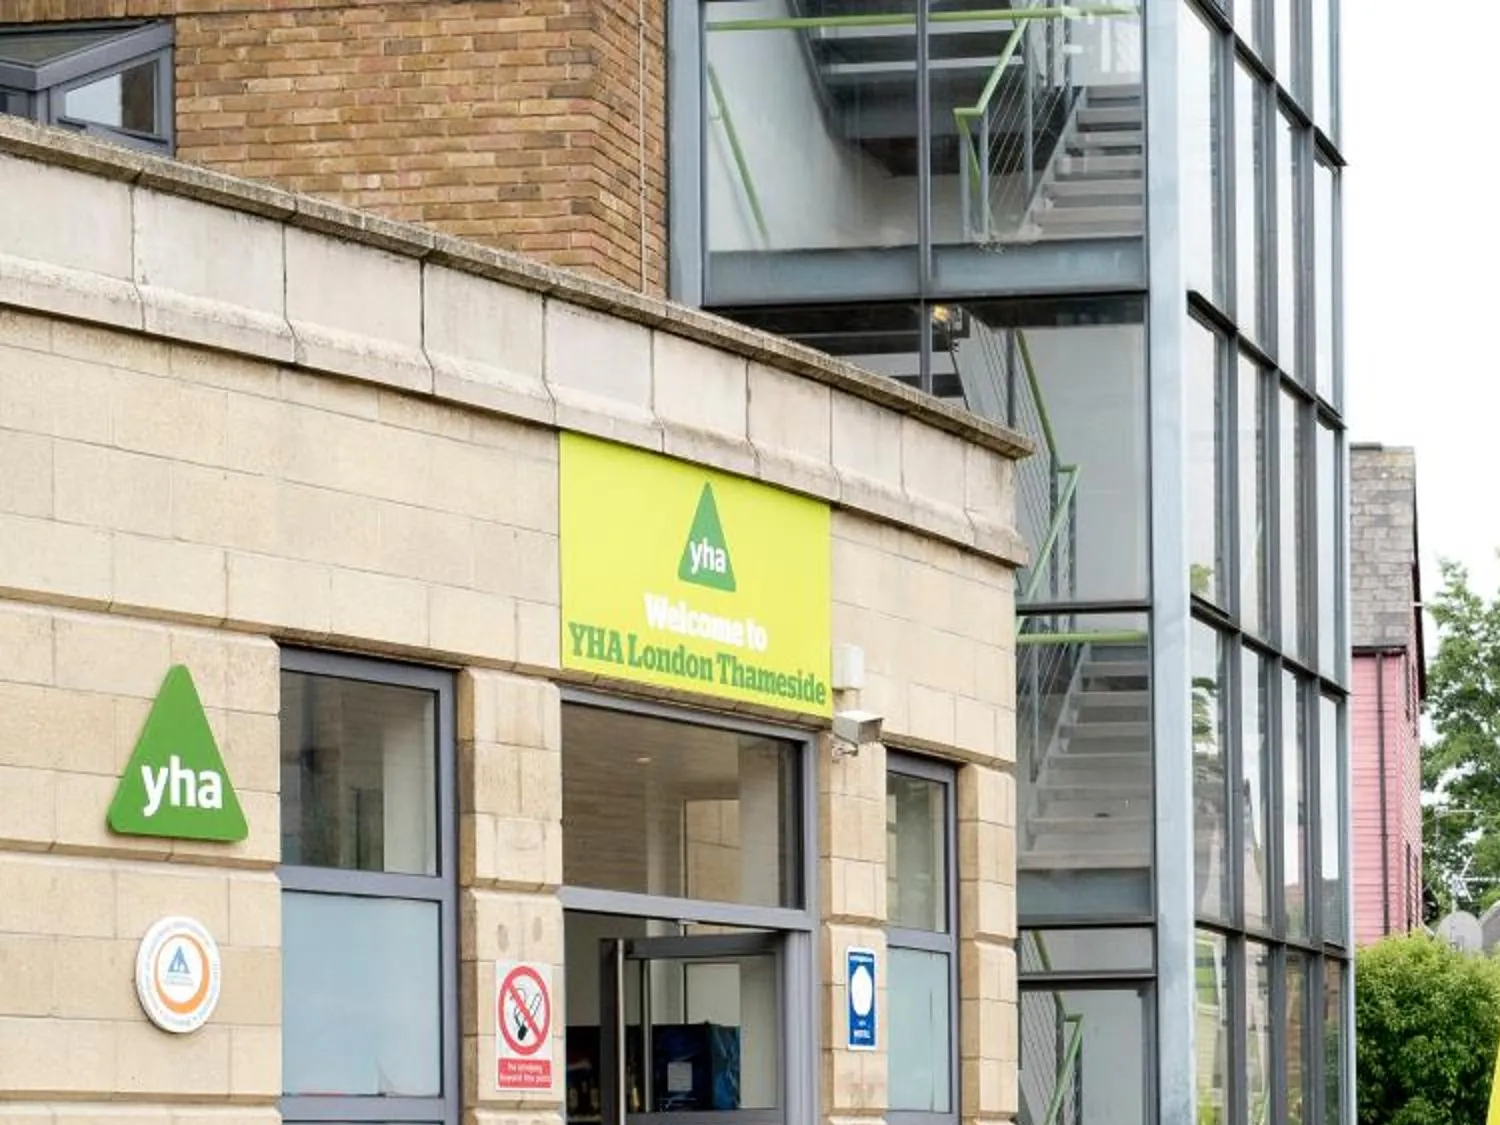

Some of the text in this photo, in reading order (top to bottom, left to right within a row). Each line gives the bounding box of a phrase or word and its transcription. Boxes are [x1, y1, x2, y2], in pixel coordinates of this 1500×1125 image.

[689, 538, 727, 574] yha
[643, 593, 768, 652] Welcome to
[568, 621, 826, 705] YHA London Thameside
[140, 755, 223, 817] yha
